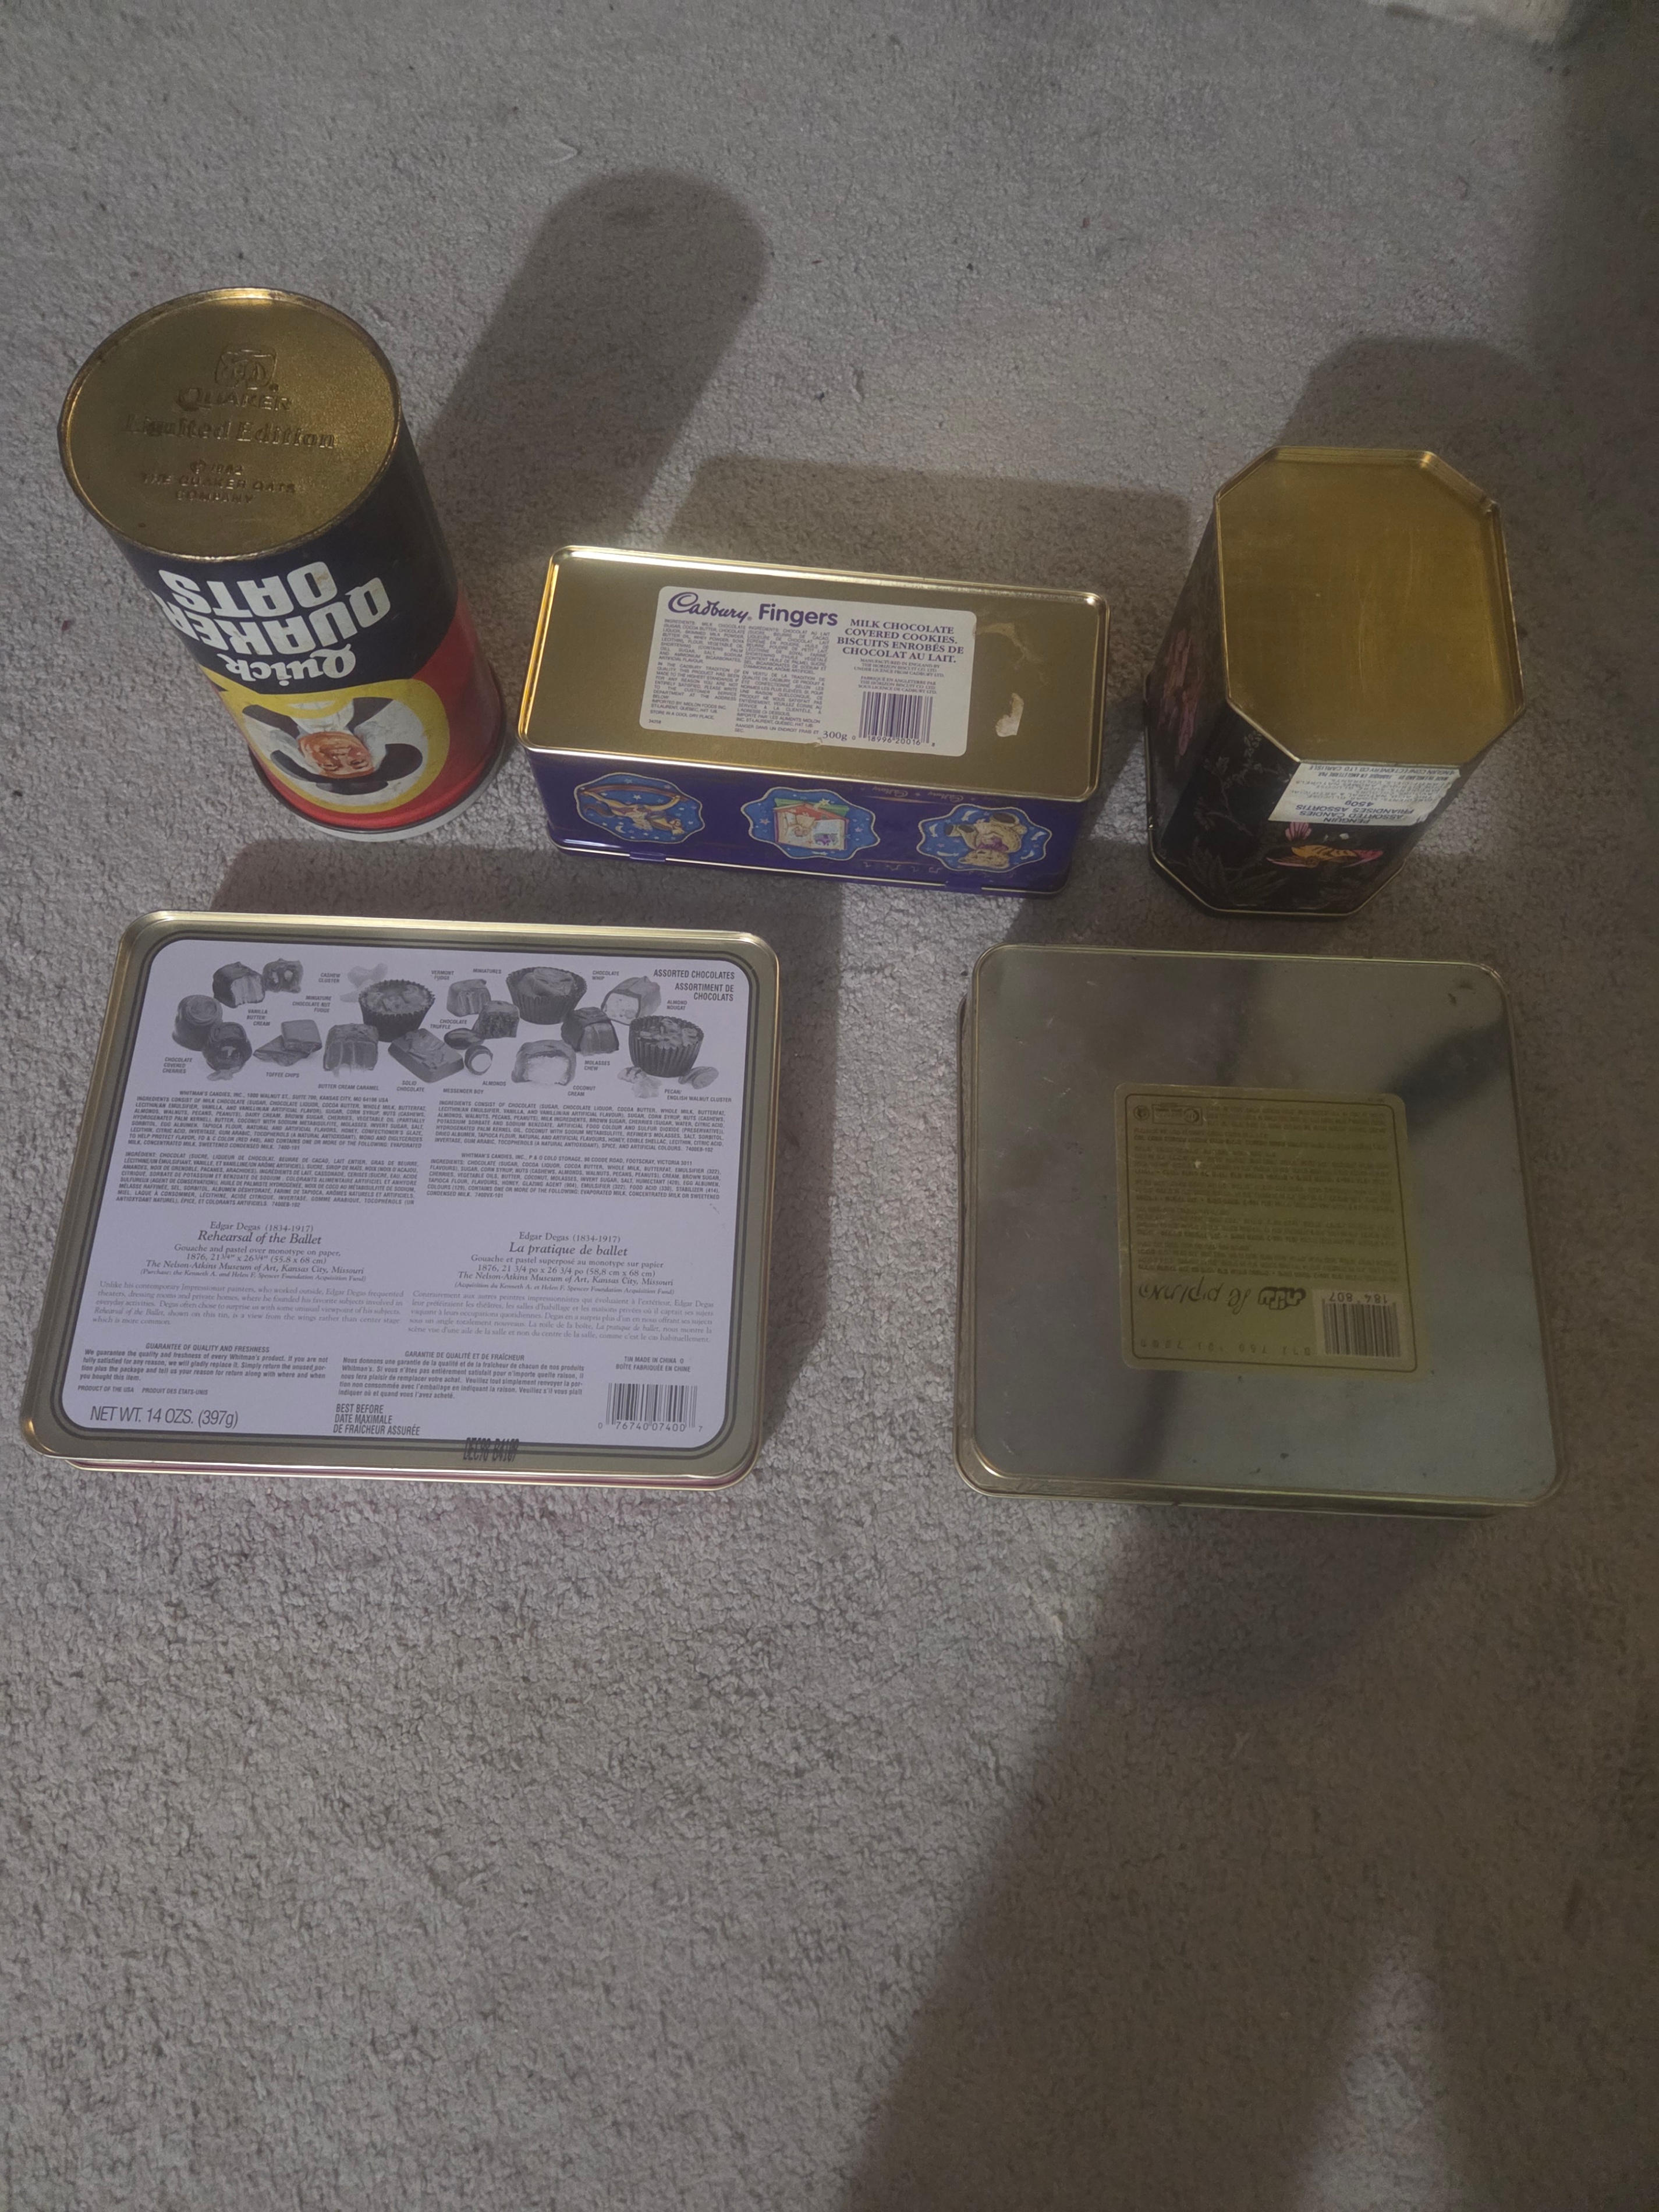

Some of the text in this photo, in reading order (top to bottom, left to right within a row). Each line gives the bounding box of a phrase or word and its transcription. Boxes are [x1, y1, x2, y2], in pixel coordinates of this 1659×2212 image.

[236, 421, 335, 448] Edition
[159, 562, 337, 618] OATS
[151, 577, 391, 655] QUAKER
[668, 591, 838, 628] Cadbury Fingers
[850, 619, 953, 633] MILK CHOCOLATE
[845, 628, 957, 643] COVERED COOKIES.
[837, 637, 963, 654] BISCUITS ENROBÉS DE
[842, 647, 906, 658] CHOCOLAT
[928, 654, 956, 662] LAIT.
[217, 644, 356, 686] Quick
[823, 731, 847, 741] 300g
[653, 969, 735, 979] ASSORTED CHOCOLATES
[675, 983, 722, 991] ASSORTIMENT
[693, 992, 733, 1001] CHOCOLATS
[210, 1221, 233, 1231] Edgar
[236, 1222, 260, 1232] Degas
[198, 1231, 321, 1244] Rehearsal of the Ballet
[519, 1231, 542, 1241] Edgar
[545, 1232, 569, 1242] Degas
[174, 1244, 207, 1252] Gouache
[225, 1246, 247, 1254] pastel
[509, 1242, 628, 1256] La pratique de ballet
[163, 1260, 216, 1268] Nelson-Atkins
[219, 1262, 251, 1270] Museum
[254, 1264, 262, 1272] of
[263, 1264, 278, 1272] Art,
[311, 1265, 328, 1274] City,
[471, 1254, 504, 1263] Gouache
[516, 1256, 537, 1265] pastel
[539, 1259, 575, 1267] superposé
[478, 1264, 499, 1272] 1876,
[560, 1267, 572, 1275] 3/4
[586, 1268, 607, 1277] (58,8
[1329, 1292, 1353, 1302] 807
[336, 1403, 384, 1413] BEST BEFORE
[90, 1406, 238, 1428] NET WT. 14 OZS. (397g)
[334, 1413, 392, 1424] DATE MAXIMALE
[333, 1424, 343, 1433] DE
[387, 1424, 420, 1435] ASSURÉE
[616, 1422, 648, 1431] 76740
[652, 1423, 685, 1432] 07400
